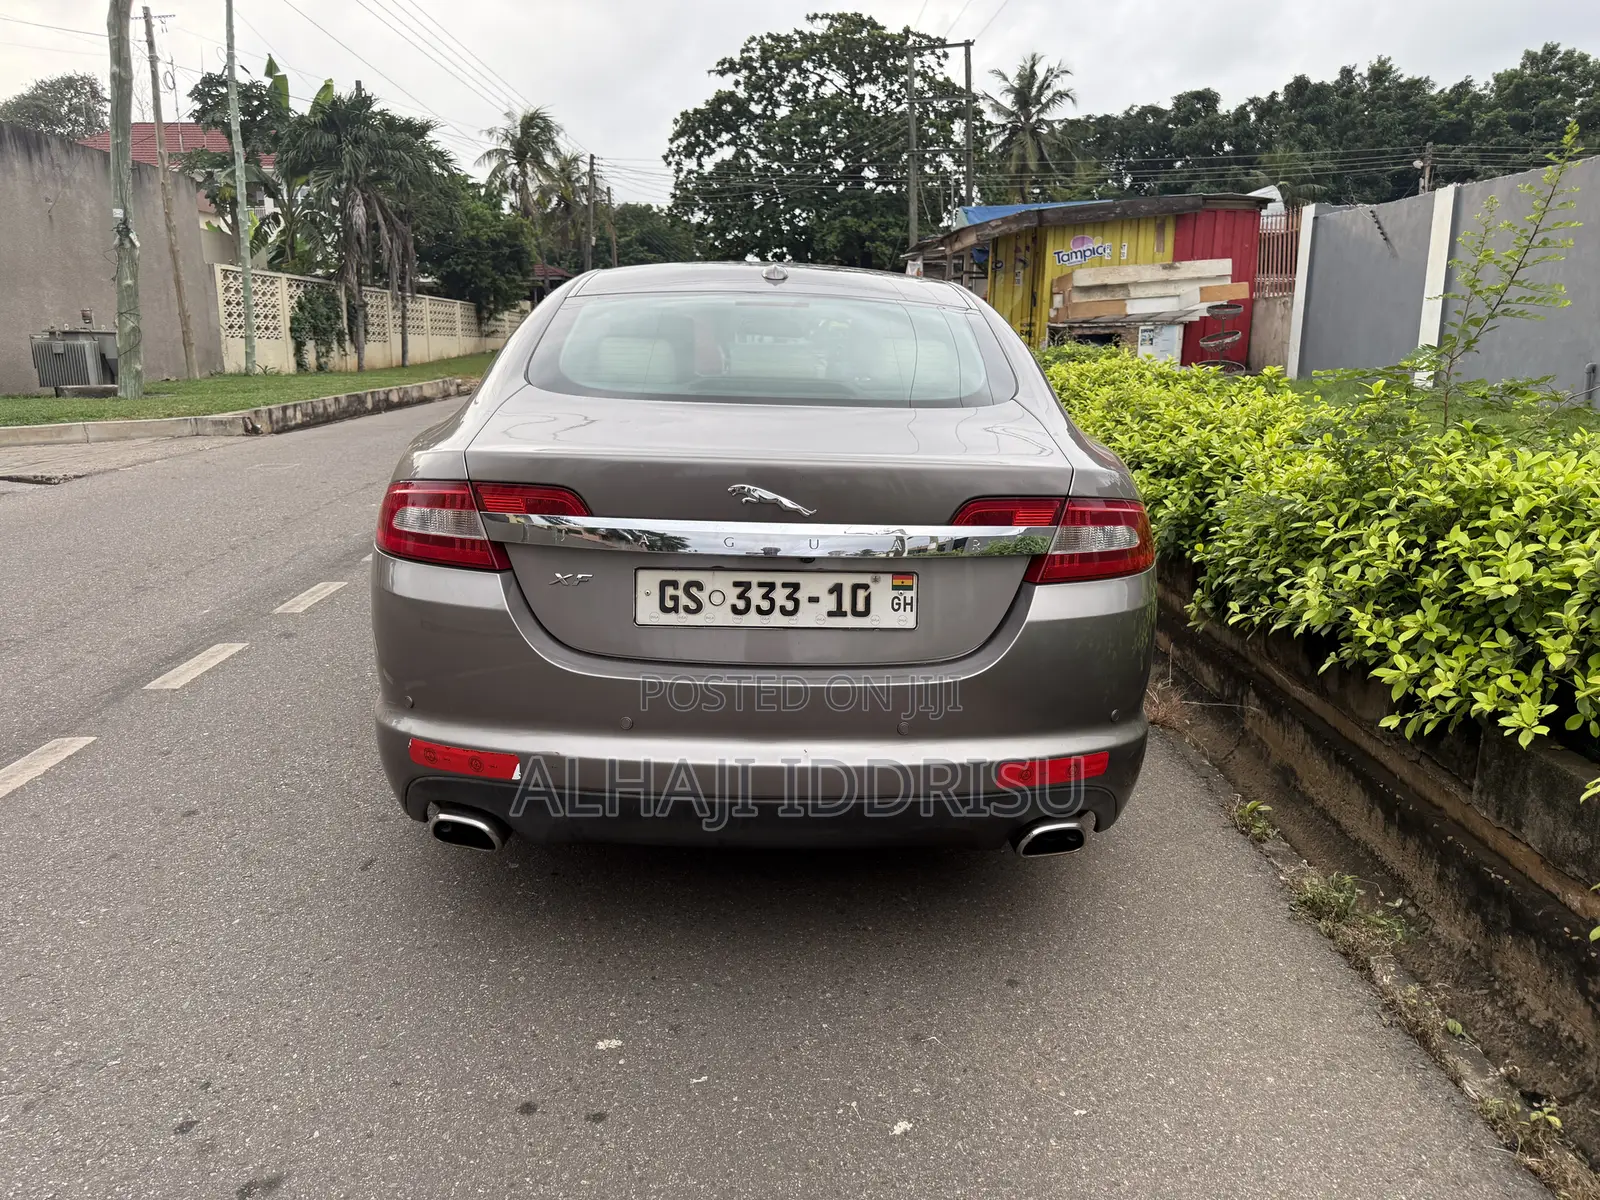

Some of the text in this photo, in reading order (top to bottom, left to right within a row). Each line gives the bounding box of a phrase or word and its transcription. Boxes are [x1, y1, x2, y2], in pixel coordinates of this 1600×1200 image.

[549, 572, 593, 586] XF
[659, 579, 871, 618] GS 333-10
[891, 595, 914, 613] GH
